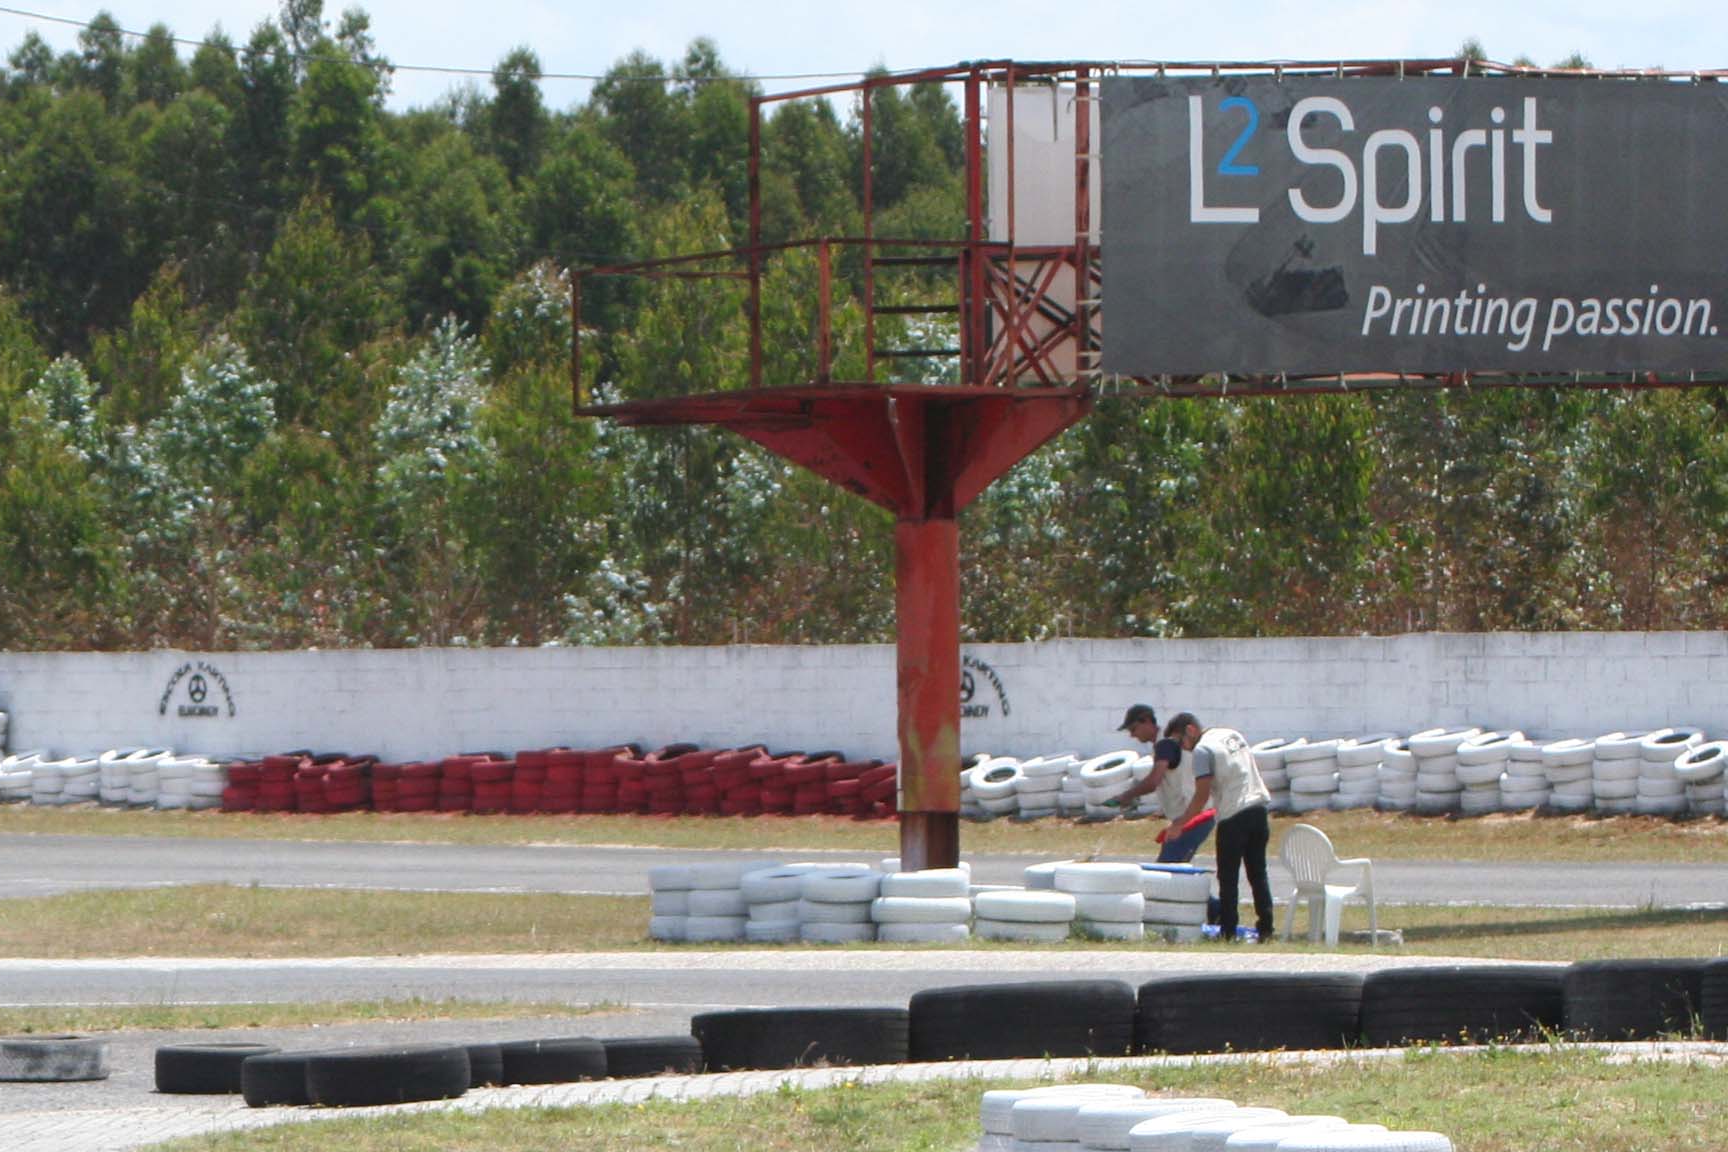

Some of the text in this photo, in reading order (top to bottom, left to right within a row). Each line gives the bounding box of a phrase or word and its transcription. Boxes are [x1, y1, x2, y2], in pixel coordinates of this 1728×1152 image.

[1362, 284, 1720, 352] Printing passion.
[963, 655, 1010, 717] KARTING
